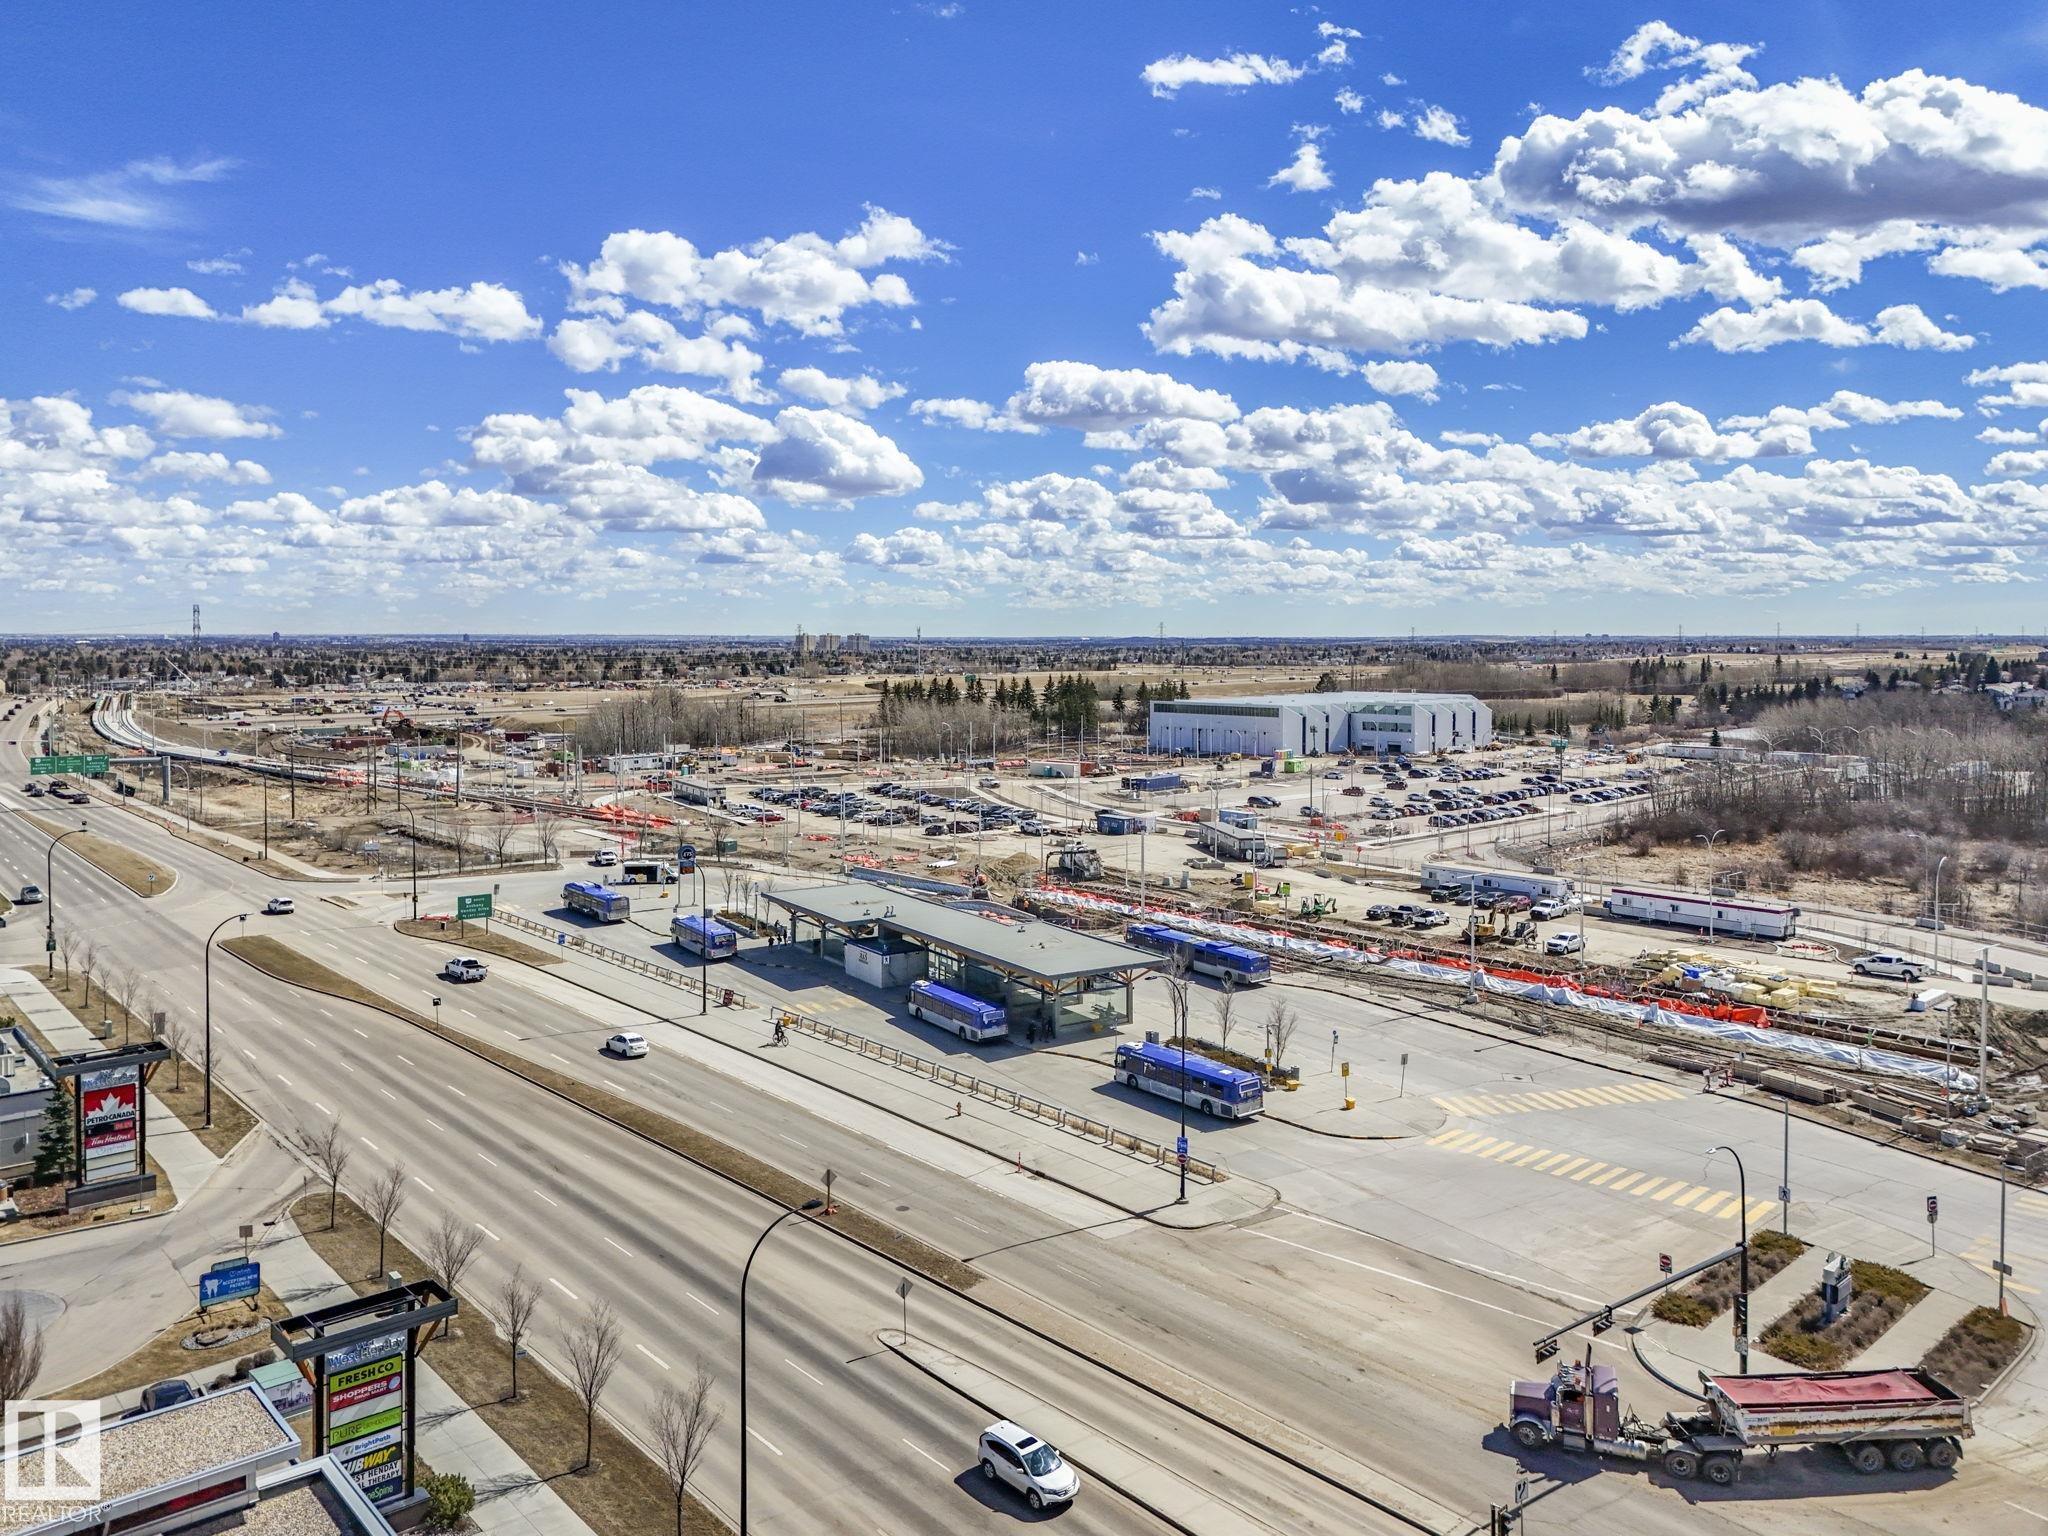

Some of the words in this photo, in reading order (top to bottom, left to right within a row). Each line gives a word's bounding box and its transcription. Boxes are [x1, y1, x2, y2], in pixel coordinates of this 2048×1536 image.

[90, 1136, 104, 1146] Tim
[105, 1132, 131, 1143] Hortons
[338, 1367, 376, 1387] FRESH
[377, 1361, 394, 1373] CO
[332, 1380, 388, 1403] SHOPPERS
[371, 1386, 387, 1395] MART
[331, 1424, 362, 1442] PURE
[354, 1433, 391, 1451] BrightPath
[368, 1461, 399, 1478] HENDAY
[368, 1469, 400, 1486] THERAPY
